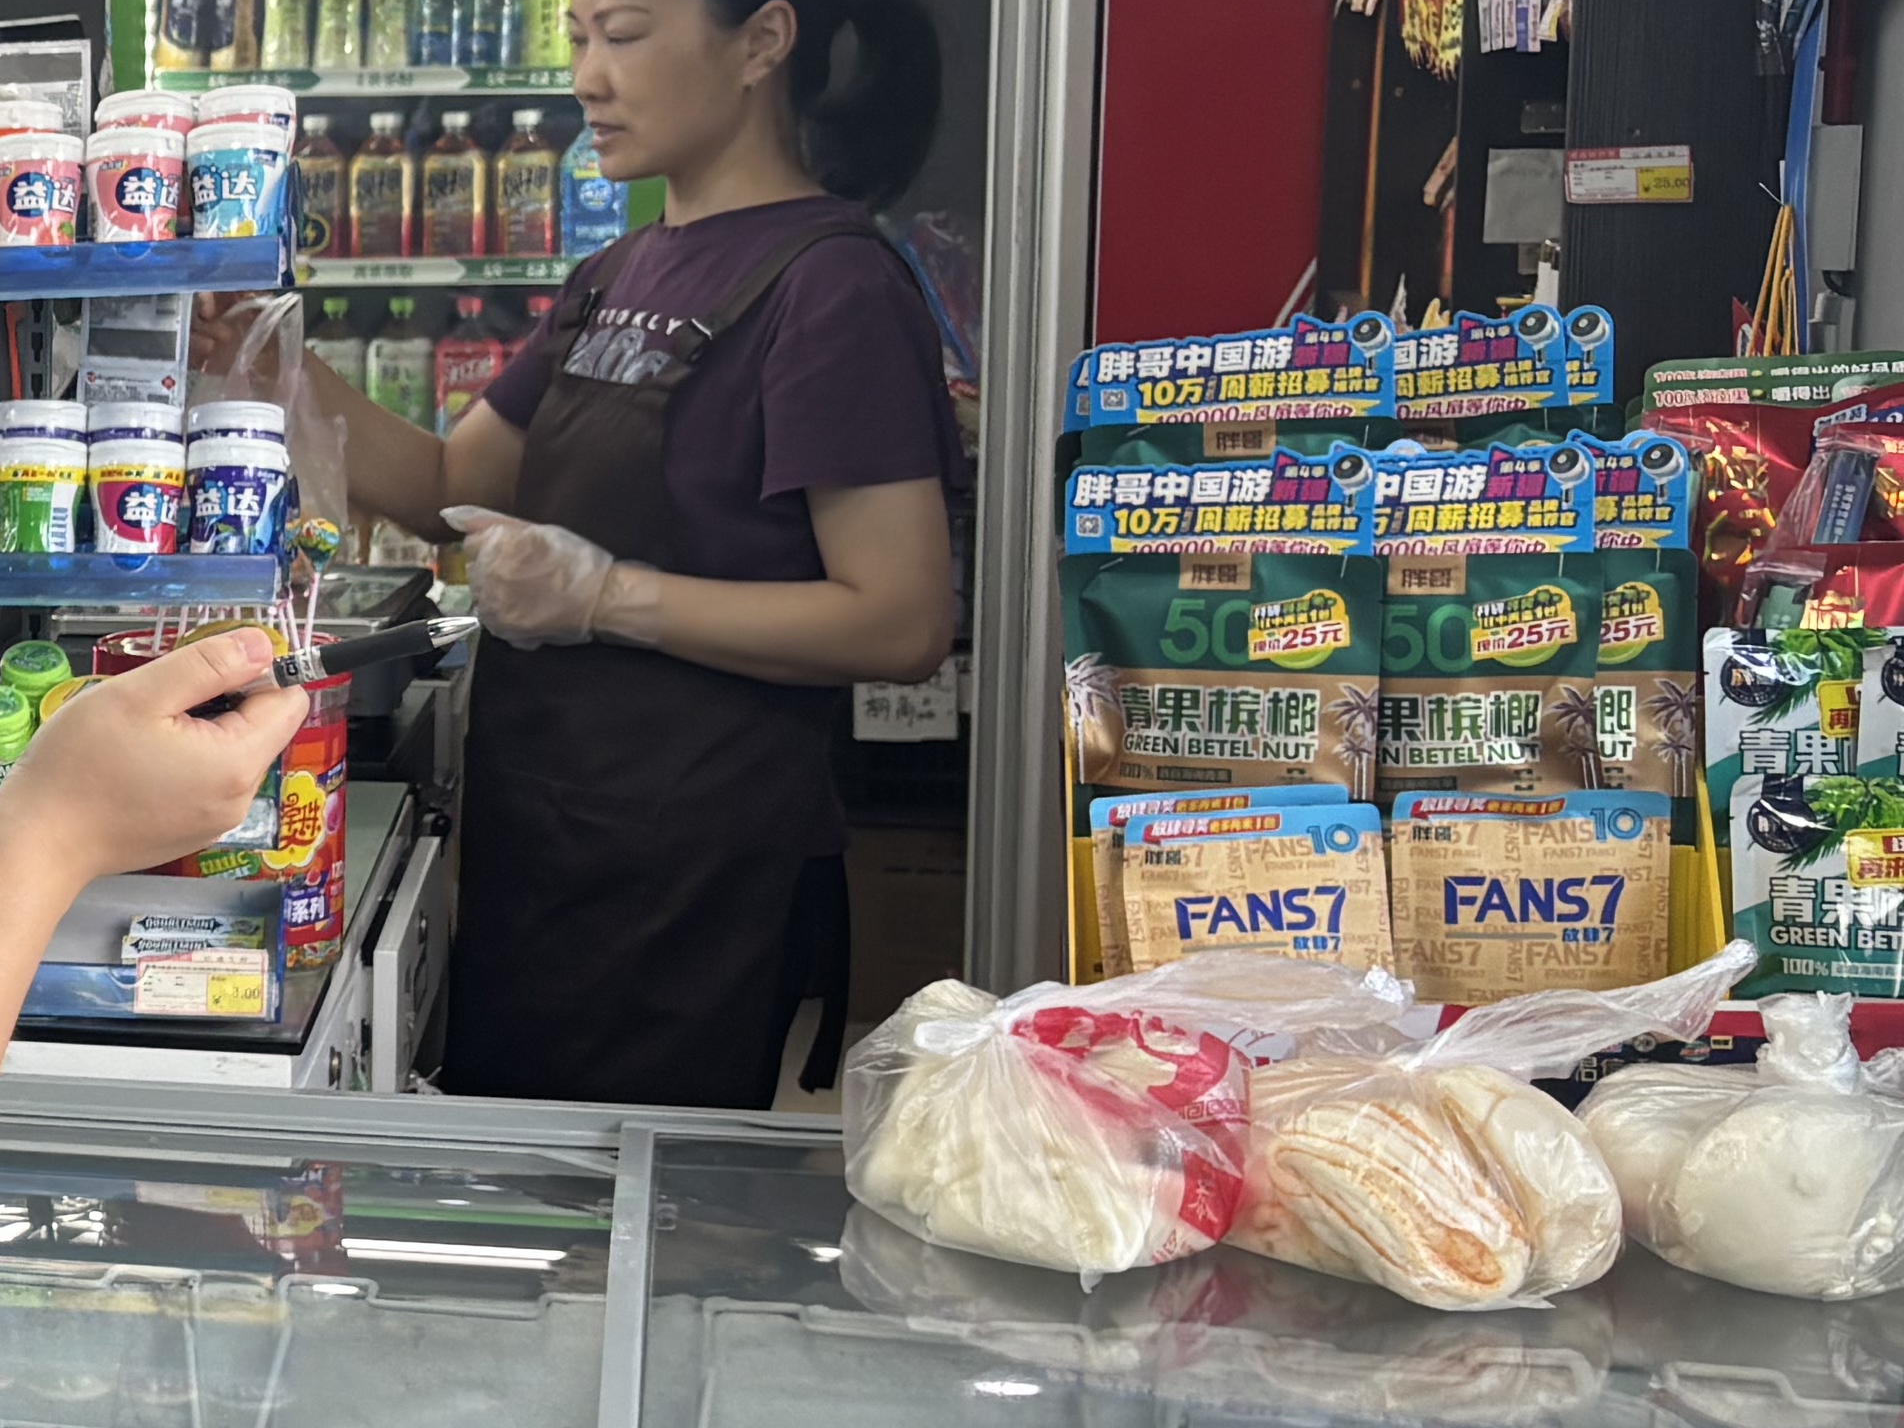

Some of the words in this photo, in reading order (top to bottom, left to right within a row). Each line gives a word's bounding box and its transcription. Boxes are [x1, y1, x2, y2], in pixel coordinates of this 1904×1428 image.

[13, 178, 75, 211] 益达
[1098, 338, 1292, 382] 胖哥中国游
[1139, 378, 1205, 406] 10万
[1220, 369, 1330, 400] 周薪招募
[195, 487, 259, 517] 益达
[1074, 470, 1272, 507] 胖哥中国游
[1114, 507, 1181, 534] 10万
[1195, 506, 1309, 532] 周薪招募
[1407, 501, 1525, 534] 周薪招募
[1121, 686, 1320, 738] 青果槟榔
[1379, 691, 1541, 742] 果槟榔
[1124, 735, 1179, 754] GREEN
[1188, 737, 1255, 758] BETEL
[1262, 740, 1316, 760] NUT
[1409, 745, 1480, 764] BETEL
[1487, 740, 1540, 763] NUT
[1739, 727, 1854, 775] 青果
[1307, 825, 1359, 855] 10
[1591, 808, 1644, 842] 10
[284, 890, 325, 923] 系列
[1175, 886, 1345, 940] FANS7
[1444, 875, 1624, 924] FANS7
[1770, 927, 1849, 948] GREEN
